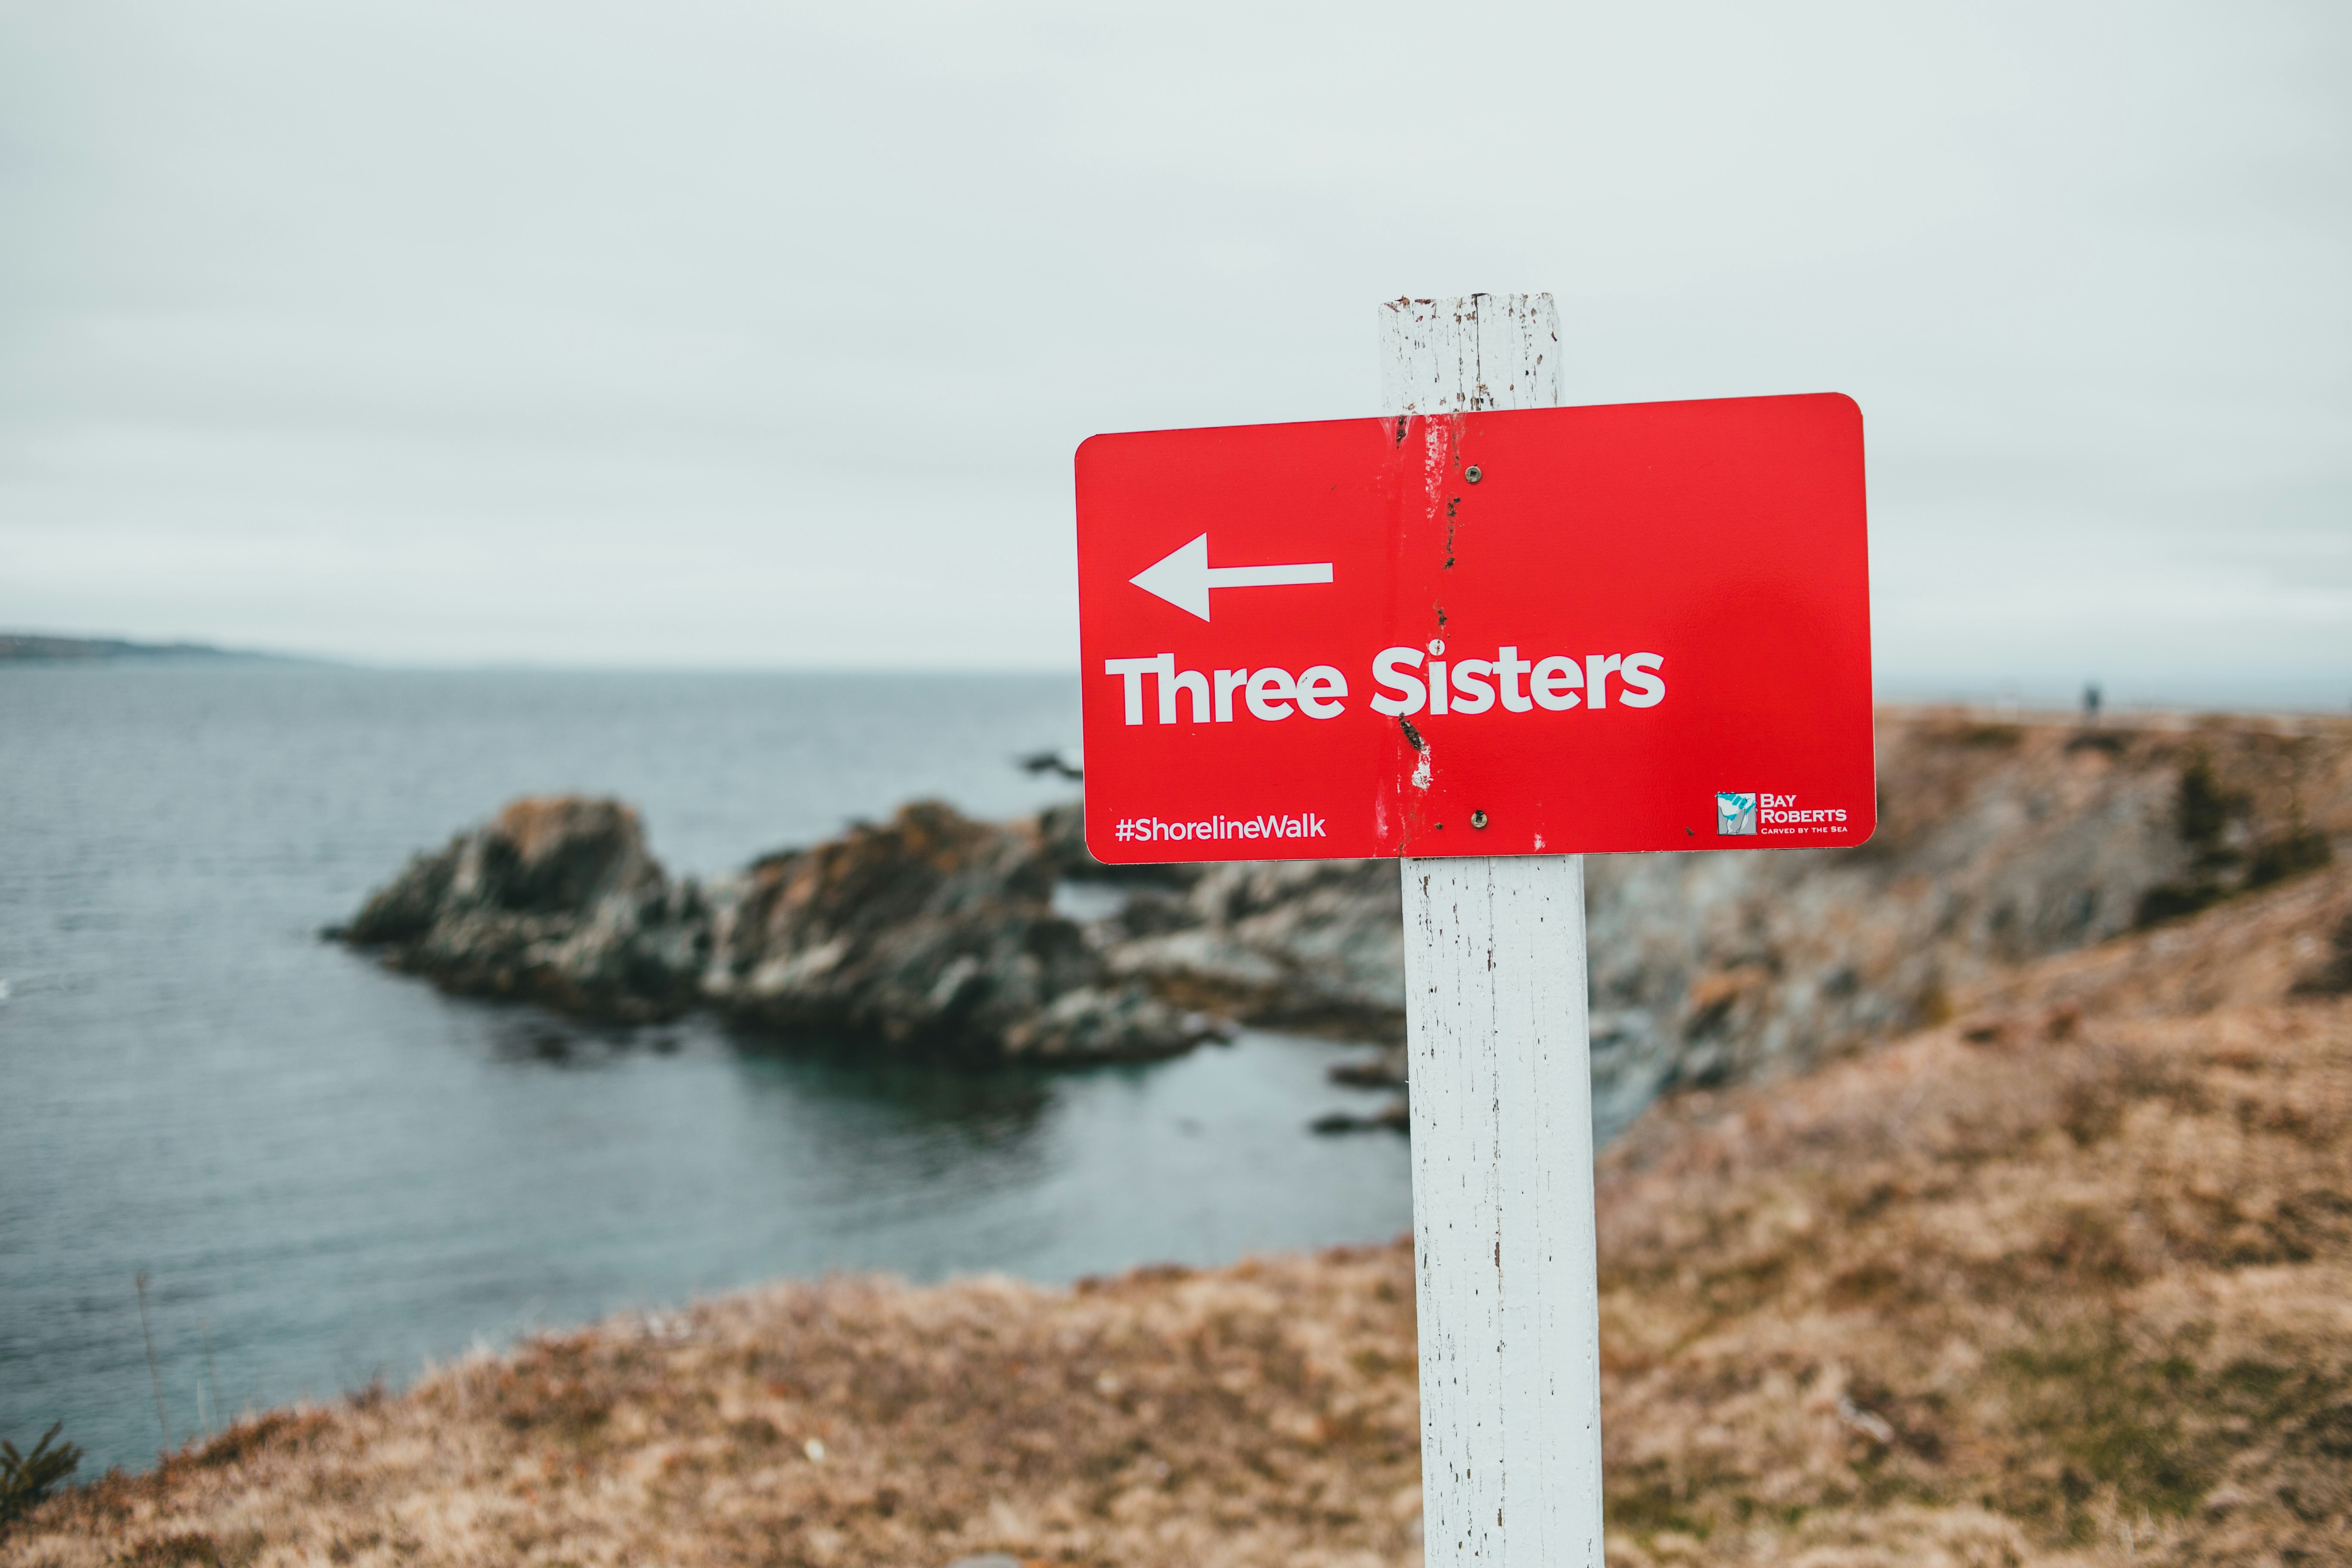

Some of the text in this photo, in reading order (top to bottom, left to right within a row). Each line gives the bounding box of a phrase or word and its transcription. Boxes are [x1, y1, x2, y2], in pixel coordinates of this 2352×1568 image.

[1105, 639, 1666, 726] Three Sisters
[1760, 793, 1797, 808] BAY
[1115, 813, 1326, 842] #ShorelineWalk
[1761, 809, 1847, 824] ROBERTS
